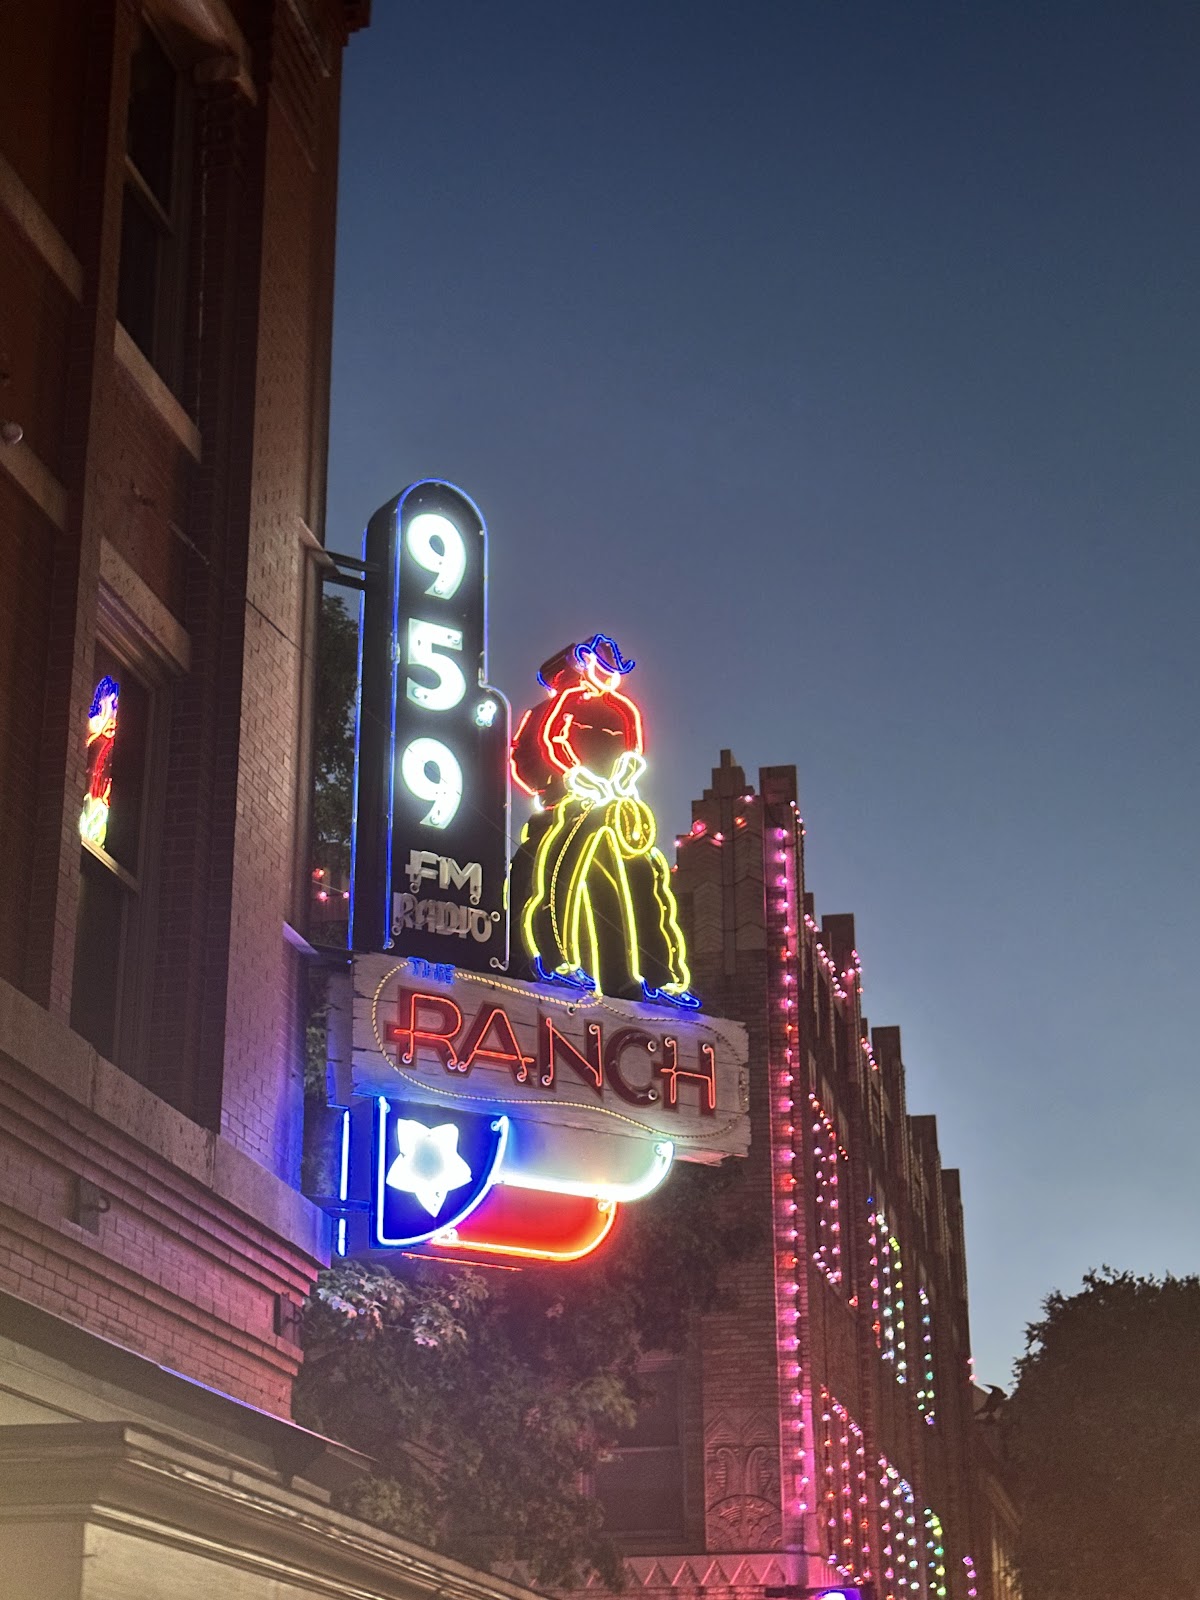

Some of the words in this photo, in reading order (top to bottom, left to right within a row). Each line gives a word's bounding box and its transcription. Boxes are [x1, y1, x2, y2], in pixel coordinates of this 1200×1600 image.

[405, 849, 483, 905] FM
[392, 891, 494, 943] RADIO
[407, 956, 456, 985] THE
[384, 985, 717, 1117] RANCH
